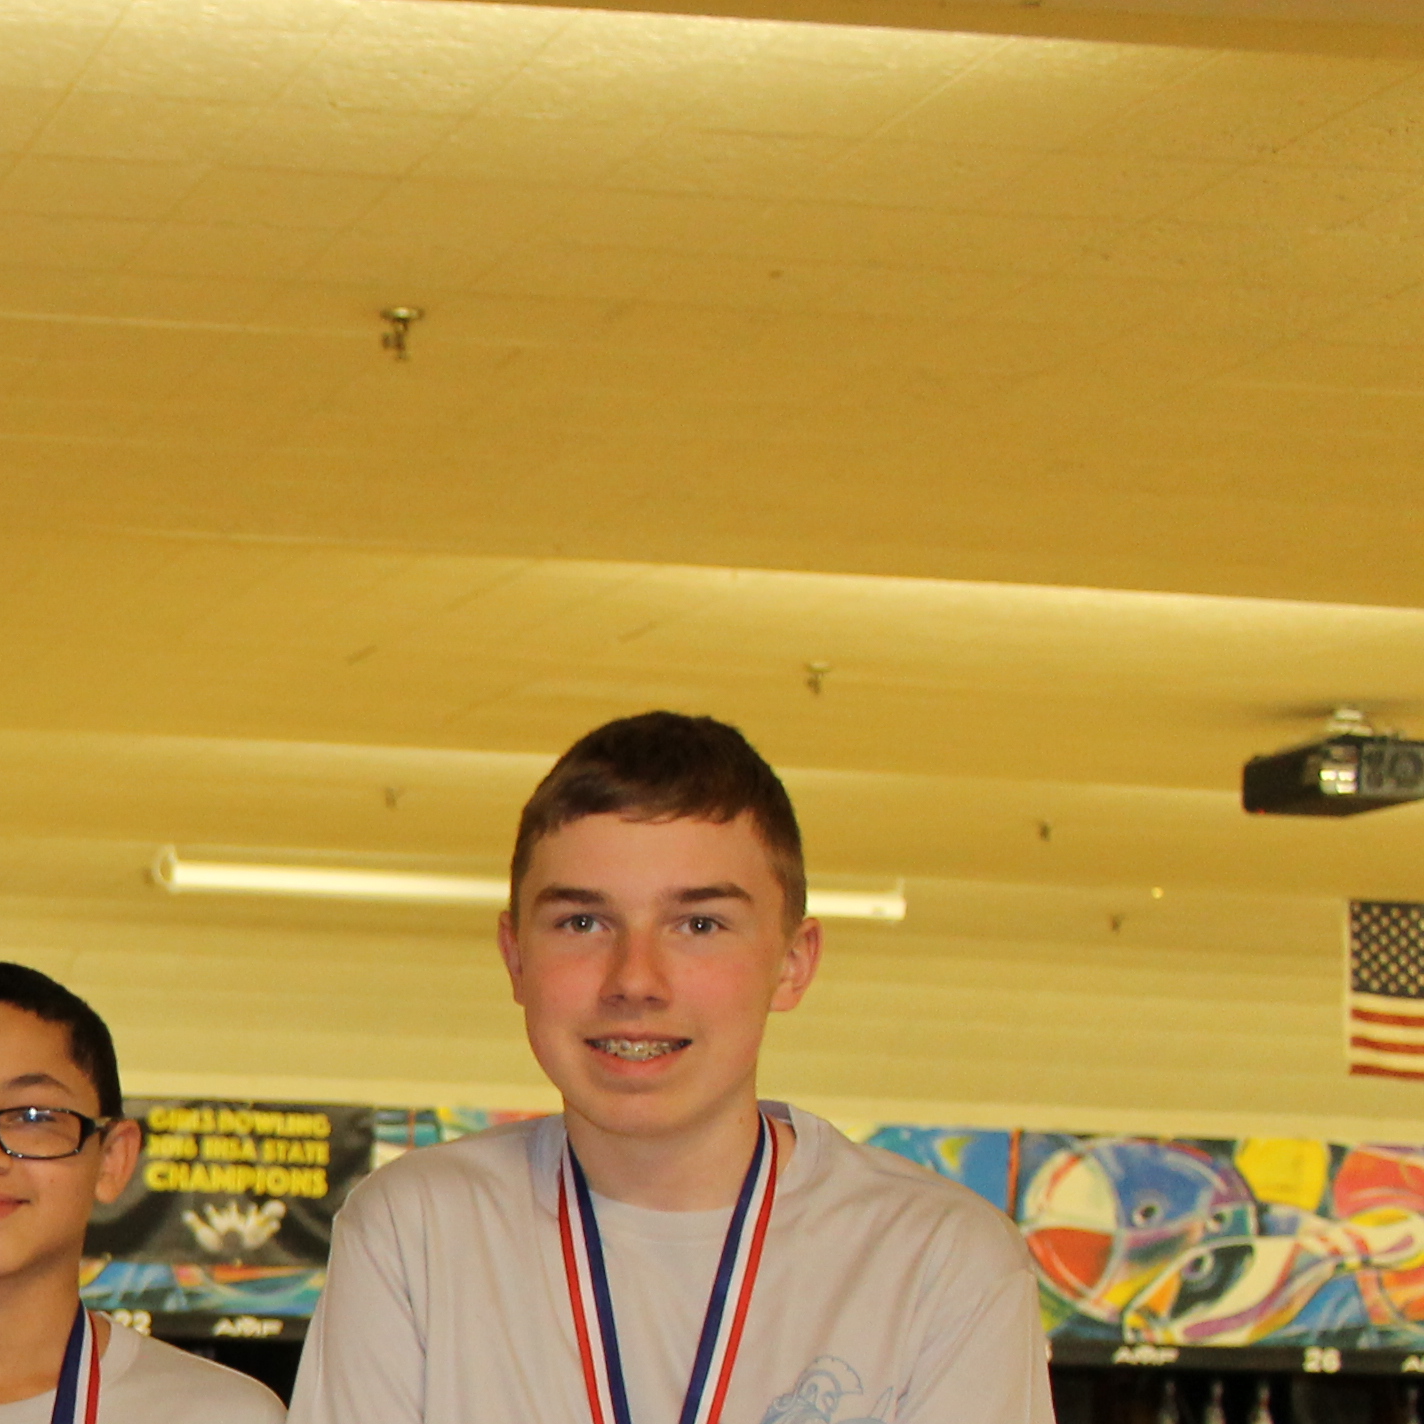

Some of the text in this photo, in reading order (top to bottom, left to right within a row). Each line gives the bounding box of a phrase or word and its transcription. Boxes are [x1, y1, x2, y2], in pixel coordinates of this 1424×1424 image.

[147, 1106, 332, 1138] GIRLS BOWLING
[262, 1138, 330, 1166] STATE
[144, 1160, 328, 1199] CHAMPIONS
